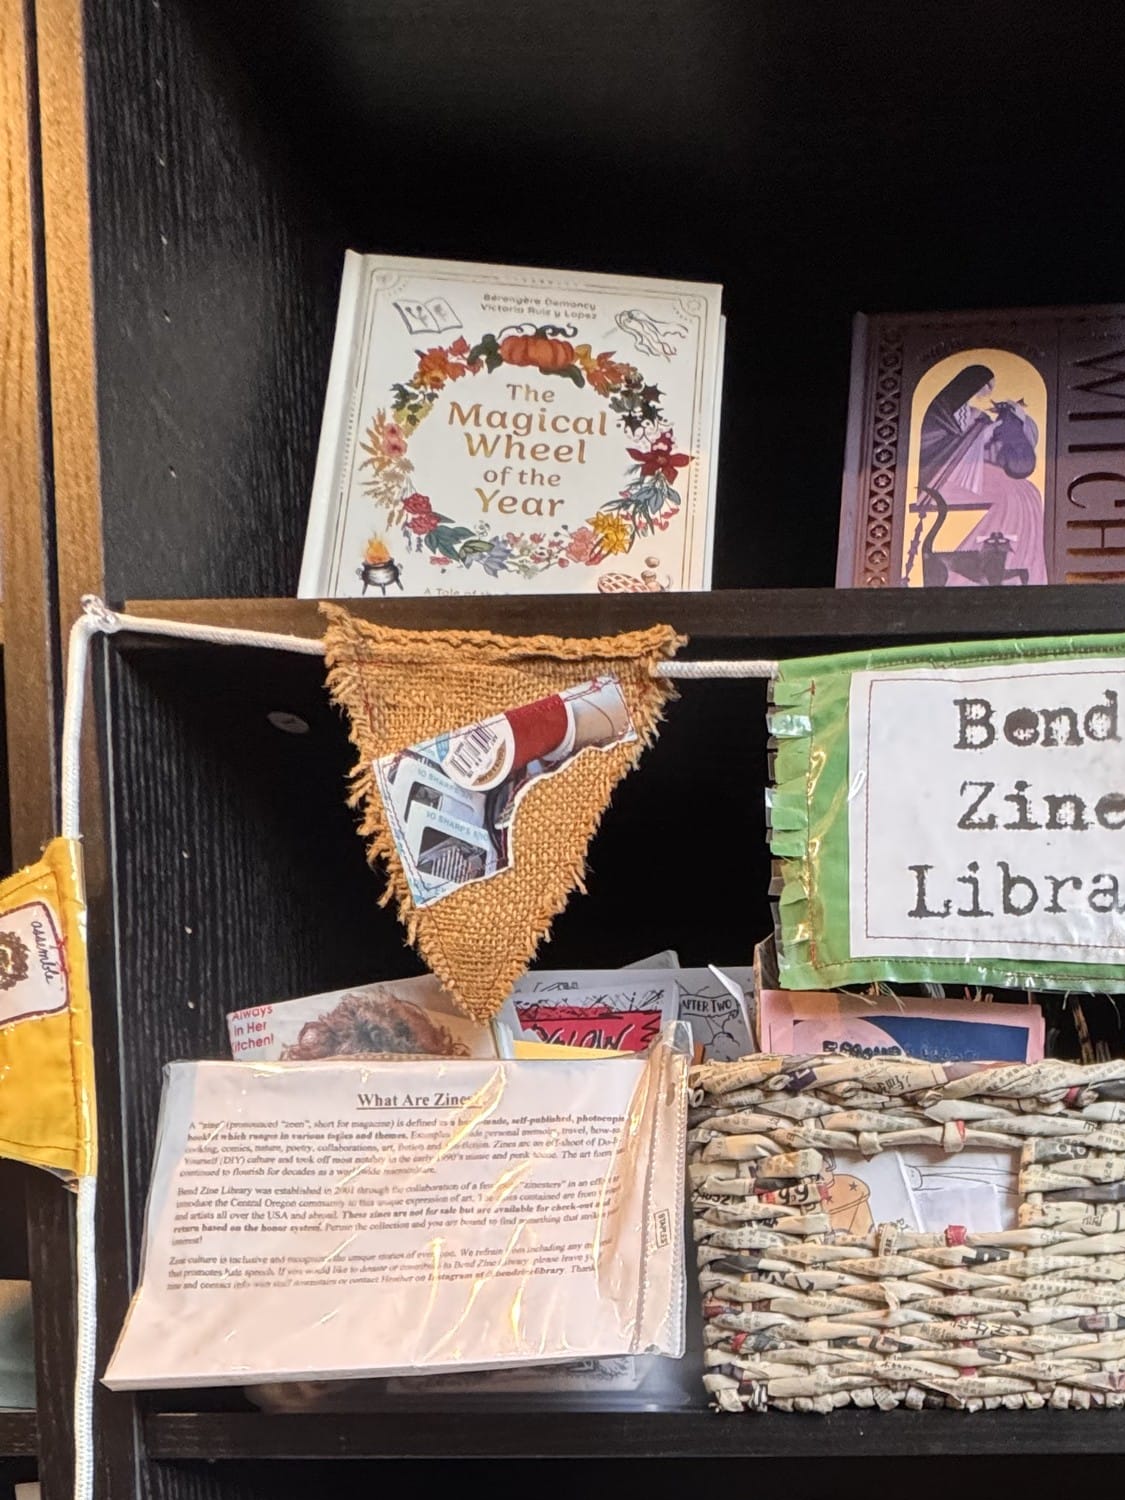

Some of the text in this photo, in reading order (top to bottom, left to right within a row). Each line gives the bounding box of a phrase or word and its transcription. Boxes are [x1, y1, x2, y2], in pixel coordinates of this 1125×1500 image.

[506, 383, 556, 404] The
[448, 401, 608, 437] Magical
[463, 432, 586, 465] Wheel
[483, 466, 562, 487] of the
[474, 488, 566, 518] Year
[952, 689, 1123, 752] Bend
[30, 919, 60, 985] assemble
[232, 1004, 273, 1021] Always
[247, 1020, 267, 1033] Her
[357, 1093, 474, 1107] What Are Zine
[313, 1114, 575, 1129] short for defined self-published,
[220, 1131, 373, 1141] which in and
[493, 1139, 517, 1149] Zines
[247, 1149, 579, 1165] culture and and The
[179, 1166, 316, 1177] continued to flourish for decades
[177, 1186, 273, 1197] Bend Zine Library was
[214, 1198, 297, 1209] the Oregon
[217, 1203, 550, 1220] all over the USA and not for sale but for
[202, 1219, 427, 1233] based the honor and
